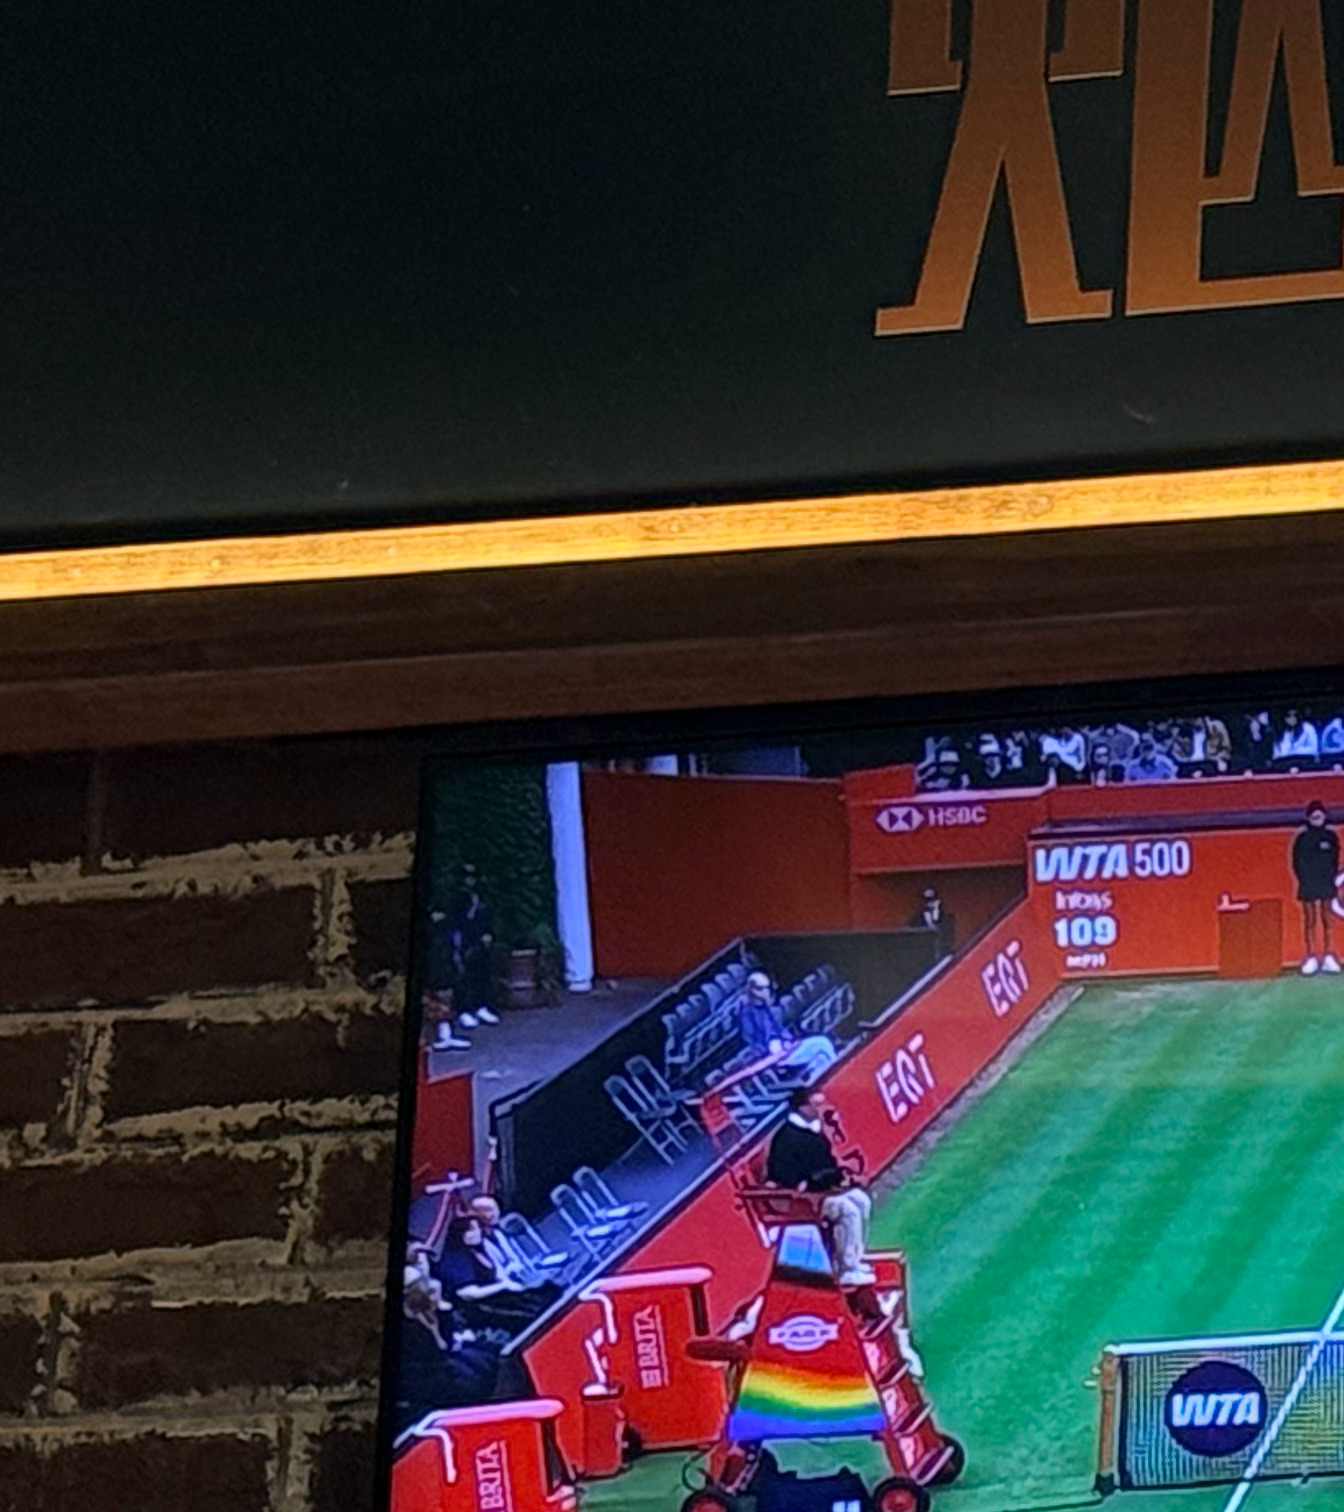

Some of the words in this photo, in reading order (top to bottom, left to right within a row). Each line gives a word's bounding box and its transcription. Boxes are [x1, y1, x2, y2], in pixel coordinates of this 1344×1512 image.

[928, 805, 987, 828] HSBC
[1035, 844, 1130, 882] WTA
[1134, 840, 1191, 877] 500
[1054, 915, 1118, 947] 109
[633, 1305, 660, 1368] BRITA
[1171, 1389, 1262, 1428] WTA
[475, 1446, 501, 1512] BRITA
